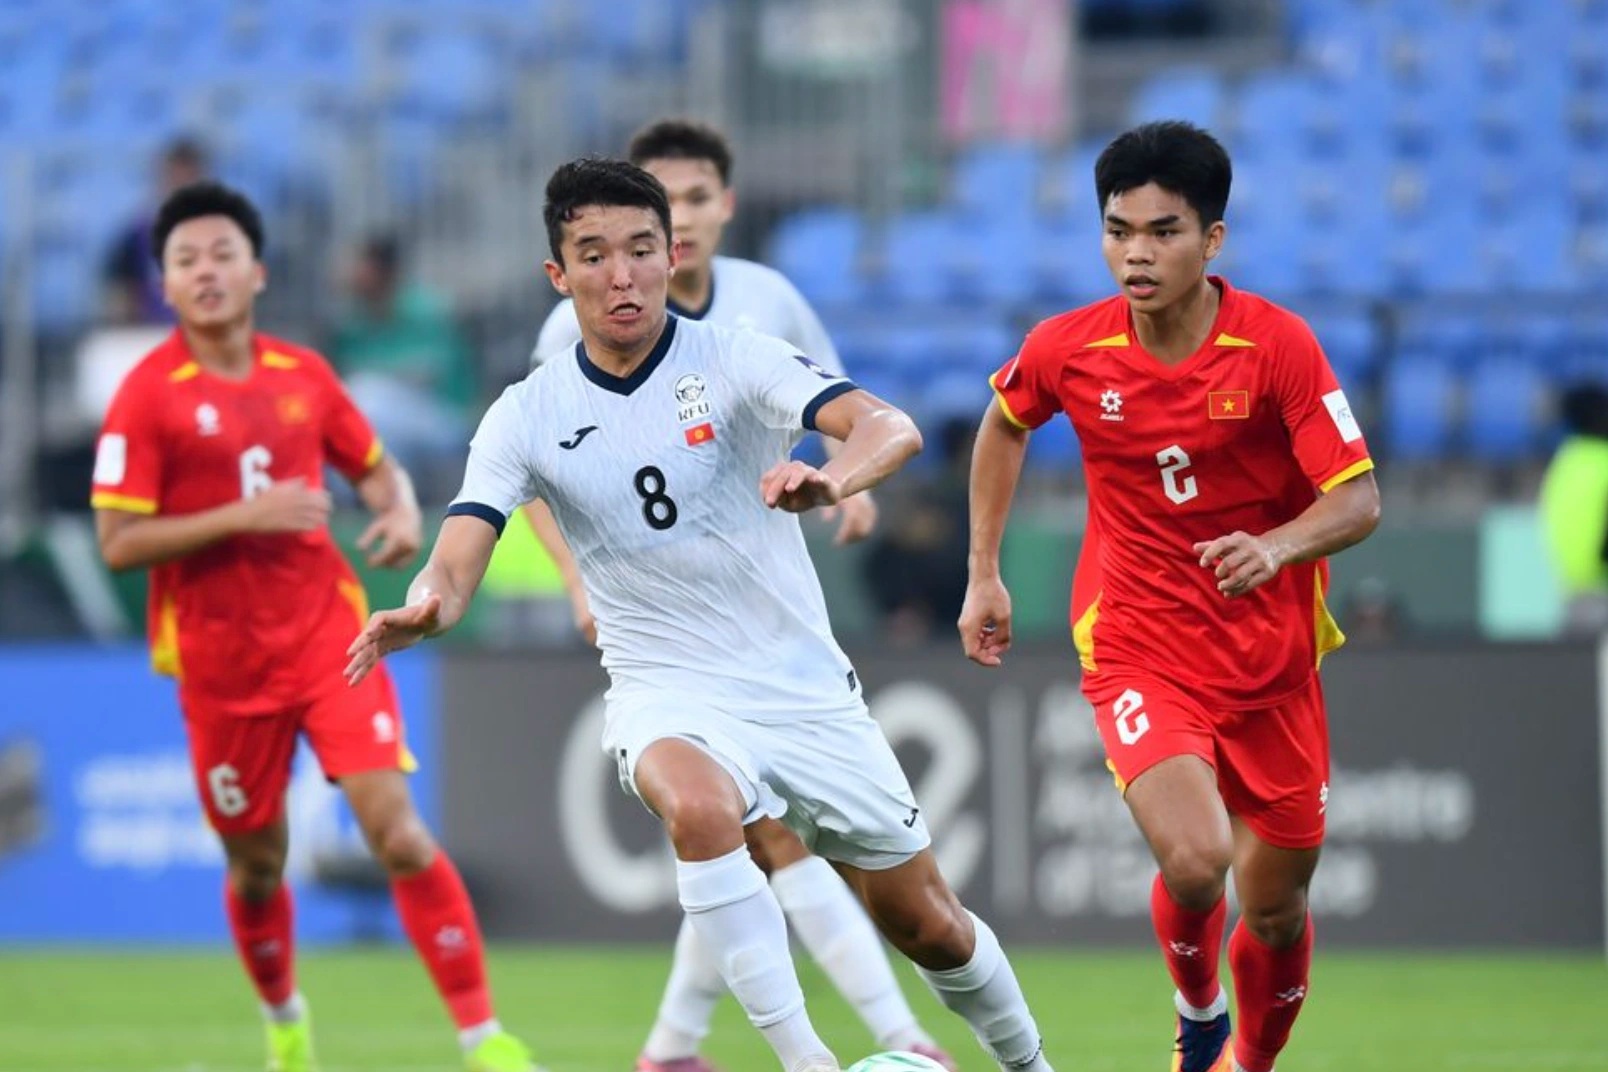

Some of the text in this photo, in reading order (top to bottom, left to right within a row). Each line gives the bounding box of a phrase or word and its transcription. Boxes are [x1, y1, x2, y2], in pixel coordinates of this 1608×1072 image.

[239, 445, 272, 501] 6
[634, 465, 677, 530] 8
[1156, 444, 1198, 504] 2
[1113, 688, 1150, 745] 2
[208, 763, 248, 818] 6
